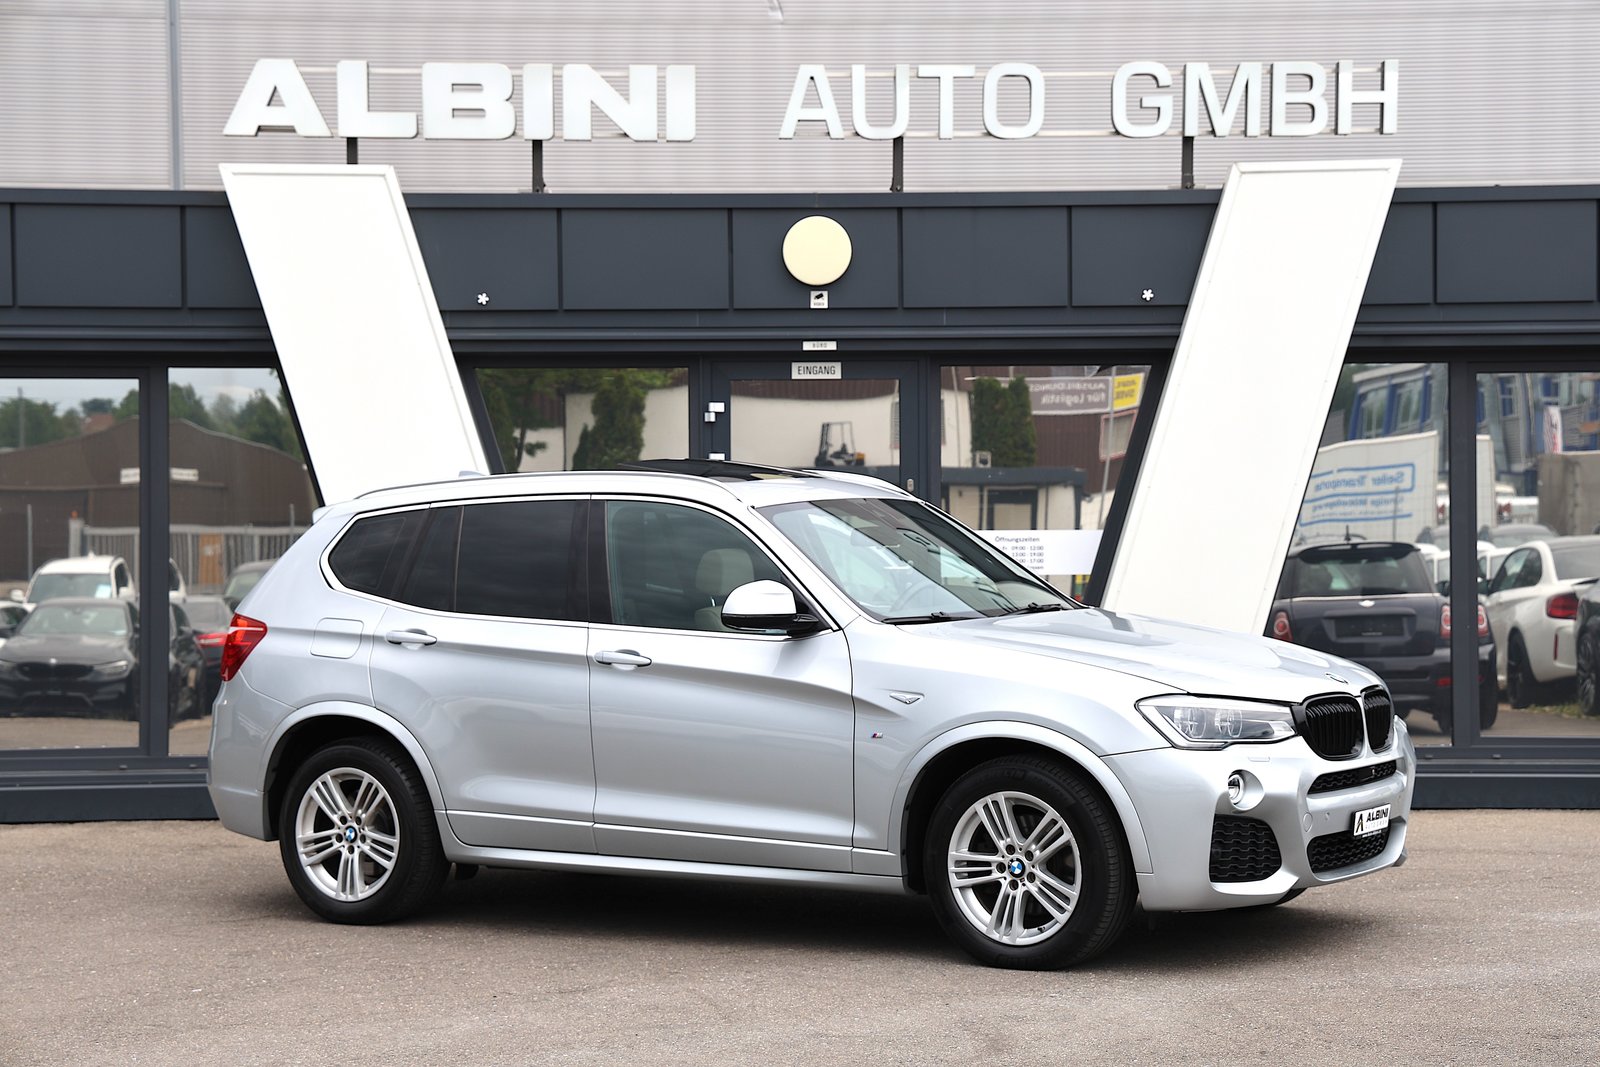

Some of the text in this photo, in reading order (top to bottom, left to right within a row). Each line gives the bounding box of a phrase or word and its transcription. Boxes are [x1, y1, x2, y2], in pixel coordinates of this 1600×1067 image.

[222, 58, 1400, 142] ALBINI AUTO GMBH
[797, 365, 836, 375] EINGANG
[1366, 807, 1389, 823] ALBINI
